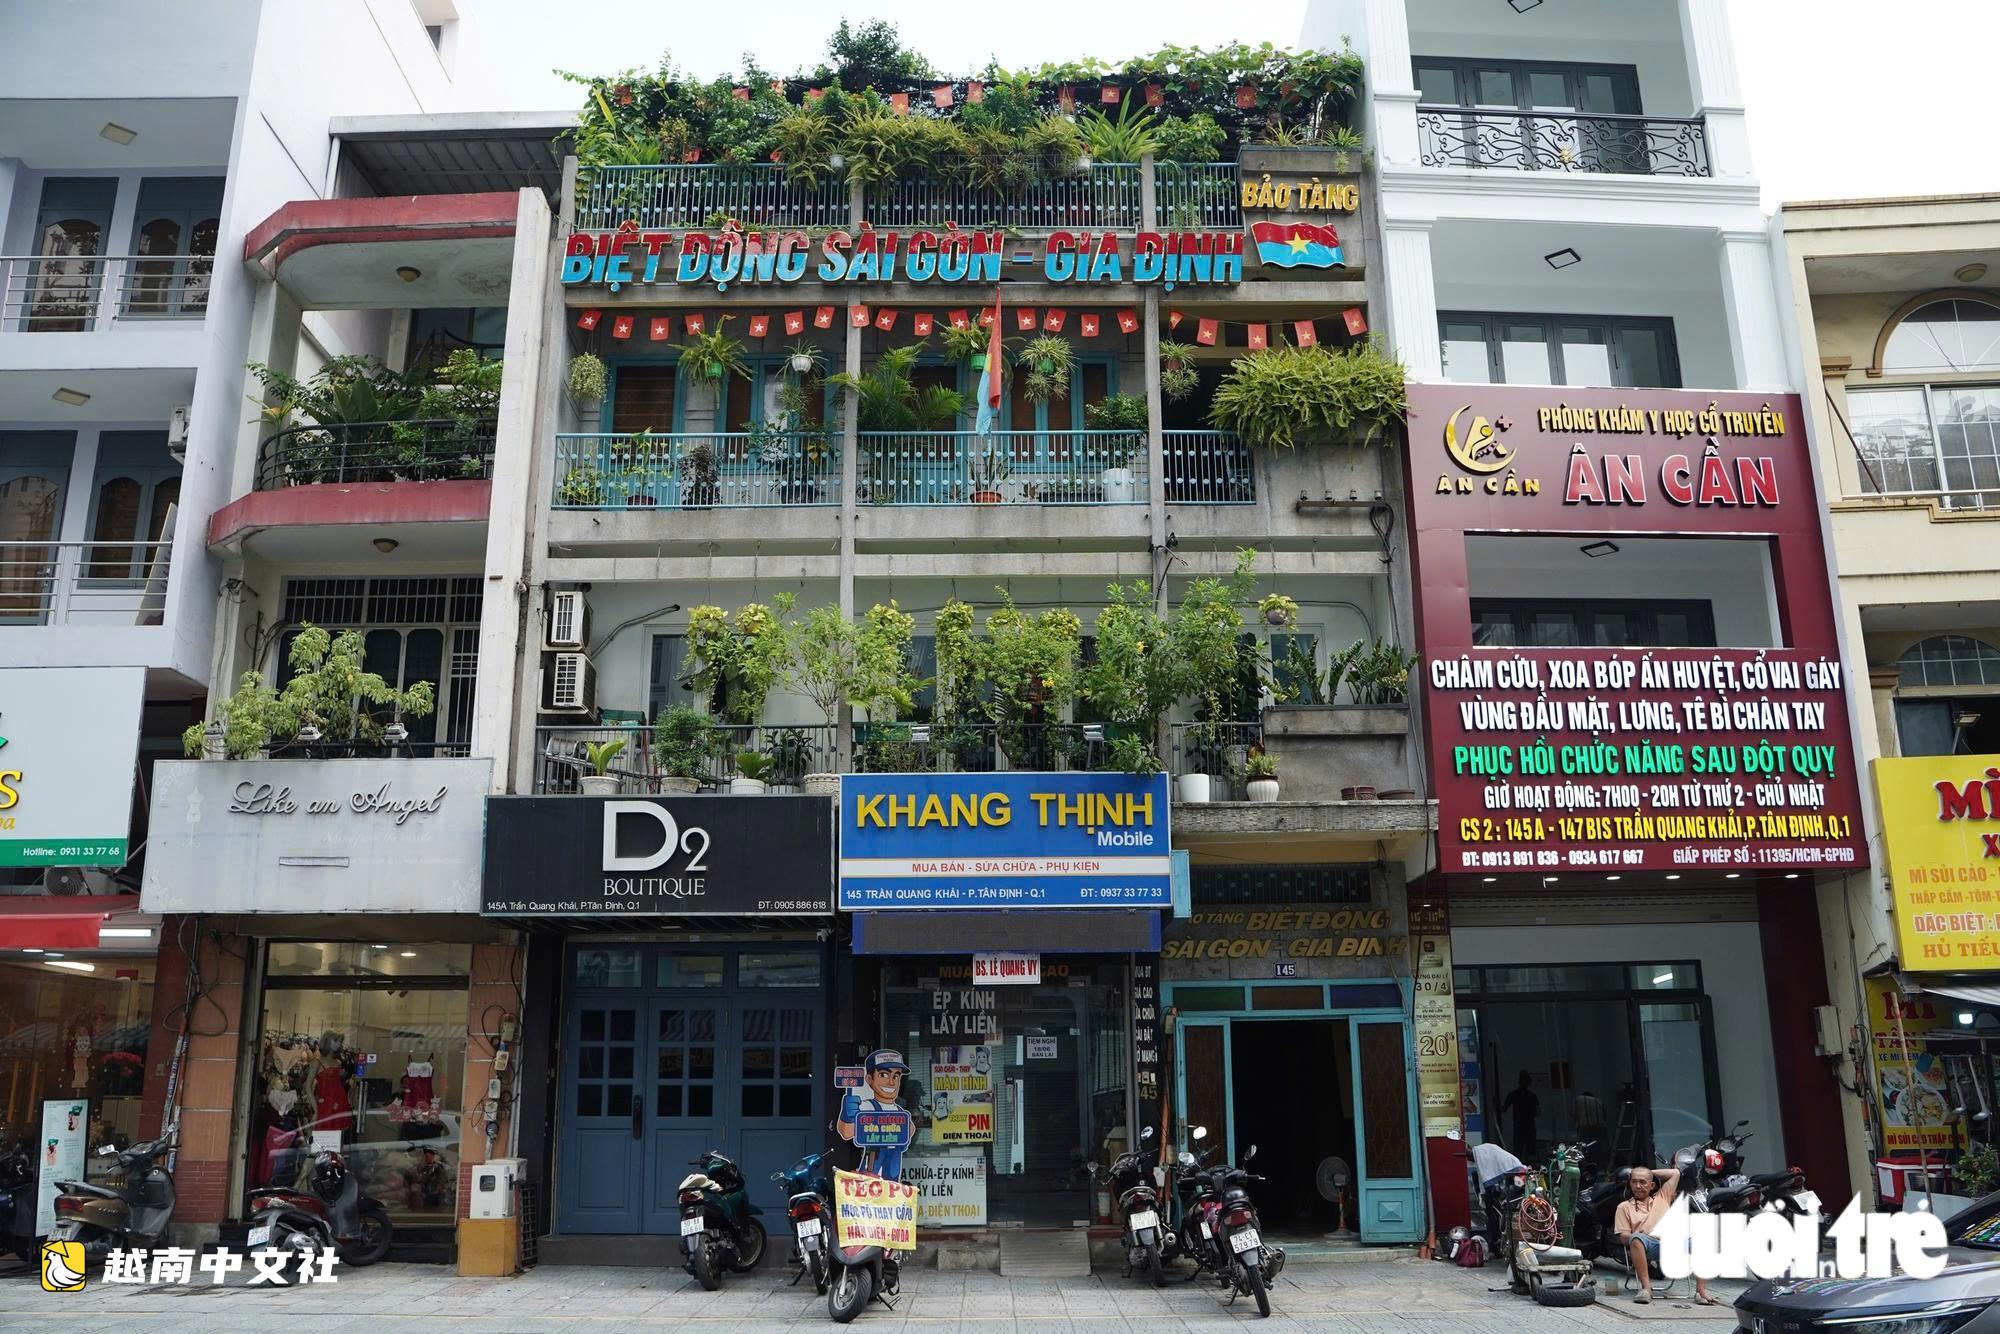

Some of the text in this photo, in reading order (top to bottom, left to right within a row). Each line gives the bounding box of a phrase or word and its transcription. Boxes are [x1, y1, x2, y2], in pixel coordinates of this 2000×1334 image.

[1242, 173, 1359, 211] BẢO TÀNG
[560, 219, 673, 293] BIỆT
[676, 219, 810, 292] ĐỘNG
[817, 221, 898, 281] SÀI
[905, 221, 1005, 282] GÒN
[1044, 231, 1122, 282] GIA
[1133, 231, 1245, 293] ĐỊNH
[1539, 401, 1785, 439] PHÒNG KHÁM Y HỌC CỔ TRUYỀN
[1565, 437, 1779, 505] ÂN CẦN
[1436, 468, 1540, 495] ÂN CẦN
[1431, 649, 1840, 694] CHÂM CỨU, XOA BÓP ẤN HUYỆT, CỔ VAI GÁY
[1460, 692, 1825, 735] VÙNG ĐẦU MẶT, LƯNG, TÊ BÌ CHÂN TAY
[1454, 735, 1835, 781] PHỤC HỒI CHỨC NĂNG SAU ĐỘT QUỴ
[227, 780, 448, 826] Like an Angel
[1484, 776, 1825, 812] GIỜ HOẠT ĐỘNG: 7H00 20H TỪ THỨ 2 CHỦ NHẬT
[856, 792, 1153, 835] KHANG THỊNH
[1460, 817, 1481, 841] CS
[1614, 808, 1655, 840] TRẦN
[1656, 816, 1705, 841] QUANG
[602, 800, 710, 872] D2
[1097, 831, 1154, 847] Mobile
[23, 847, 120, 856] Hotline: 0931 33 77 68
[1482, 851, 1511, 866] 0913
[1513, 851, 1533, 865] 891
[1537, 850, 1559, 865] 836
[1569, 850, 1597, 865] 0934
[1600, 850, 1620, 865] 617
[1622, 849, 1644, 865] 667
[1702, 846, 1731, 863] PHÉP
[1734, 845, 1750, 863] SỐ
[912, 860, 1100, 873] MUA BÁN SỬA CHỮA PHỤ KIỆN
[1909, 866, 1927, 884] MÌ
[604, 878, 706, 899] BOUTIQUE
[846, 890, 862, 900] 145
[896, 889, 931, 900] QUANG
[968, 887, 998, 899] P.TÂN
[999, 888, 1022, 901] ĐỊNH
[1031, 888, 1045, 899] Q.1
[1100, 888, 1122, 898] 0937
[1124, 888, 1135, 898] 33
[1137, 888, 1149, 898] 77
[1150, 887, 1162, 898] 33
[487, 901, 507, 911] 145A
[509, 899, 527, 911] Trần
[529, 901, 555, 912] Quang
[605, 901, 625, 911] Định,
[627, 901, 640, 911] Q.1
[1910, 890, 1937, 907] THẬP
[1205, 910, 1244, 925] TÀNG
[1914, 912, 1985, 935] ĐẶC BIỆT
[1208, 935, 1272, 958] GÒN
[1288, 937, 1334, 957] GIA
[1924, 936, 1950, 958] HỦ
[975, 959, 1038, 977] BS. QUANG VY
[1275, 964, 1295, 976] 145
[933, 987, 995, 1010] ÉP KÍNH
[1143, 987, 1153, 999] CAO
[931, 1009, 996, 1034] LẤY LIỀN
[934, 1074, 987, 1090] MÀN HÌNH
[968, 1114, 990, 1130] PIN
[952, 1163, 974, 1180] KÍNH
[932, 1180, 953, 1197] LIỀN
[953, 1205, 980, 1219] THOẠI
